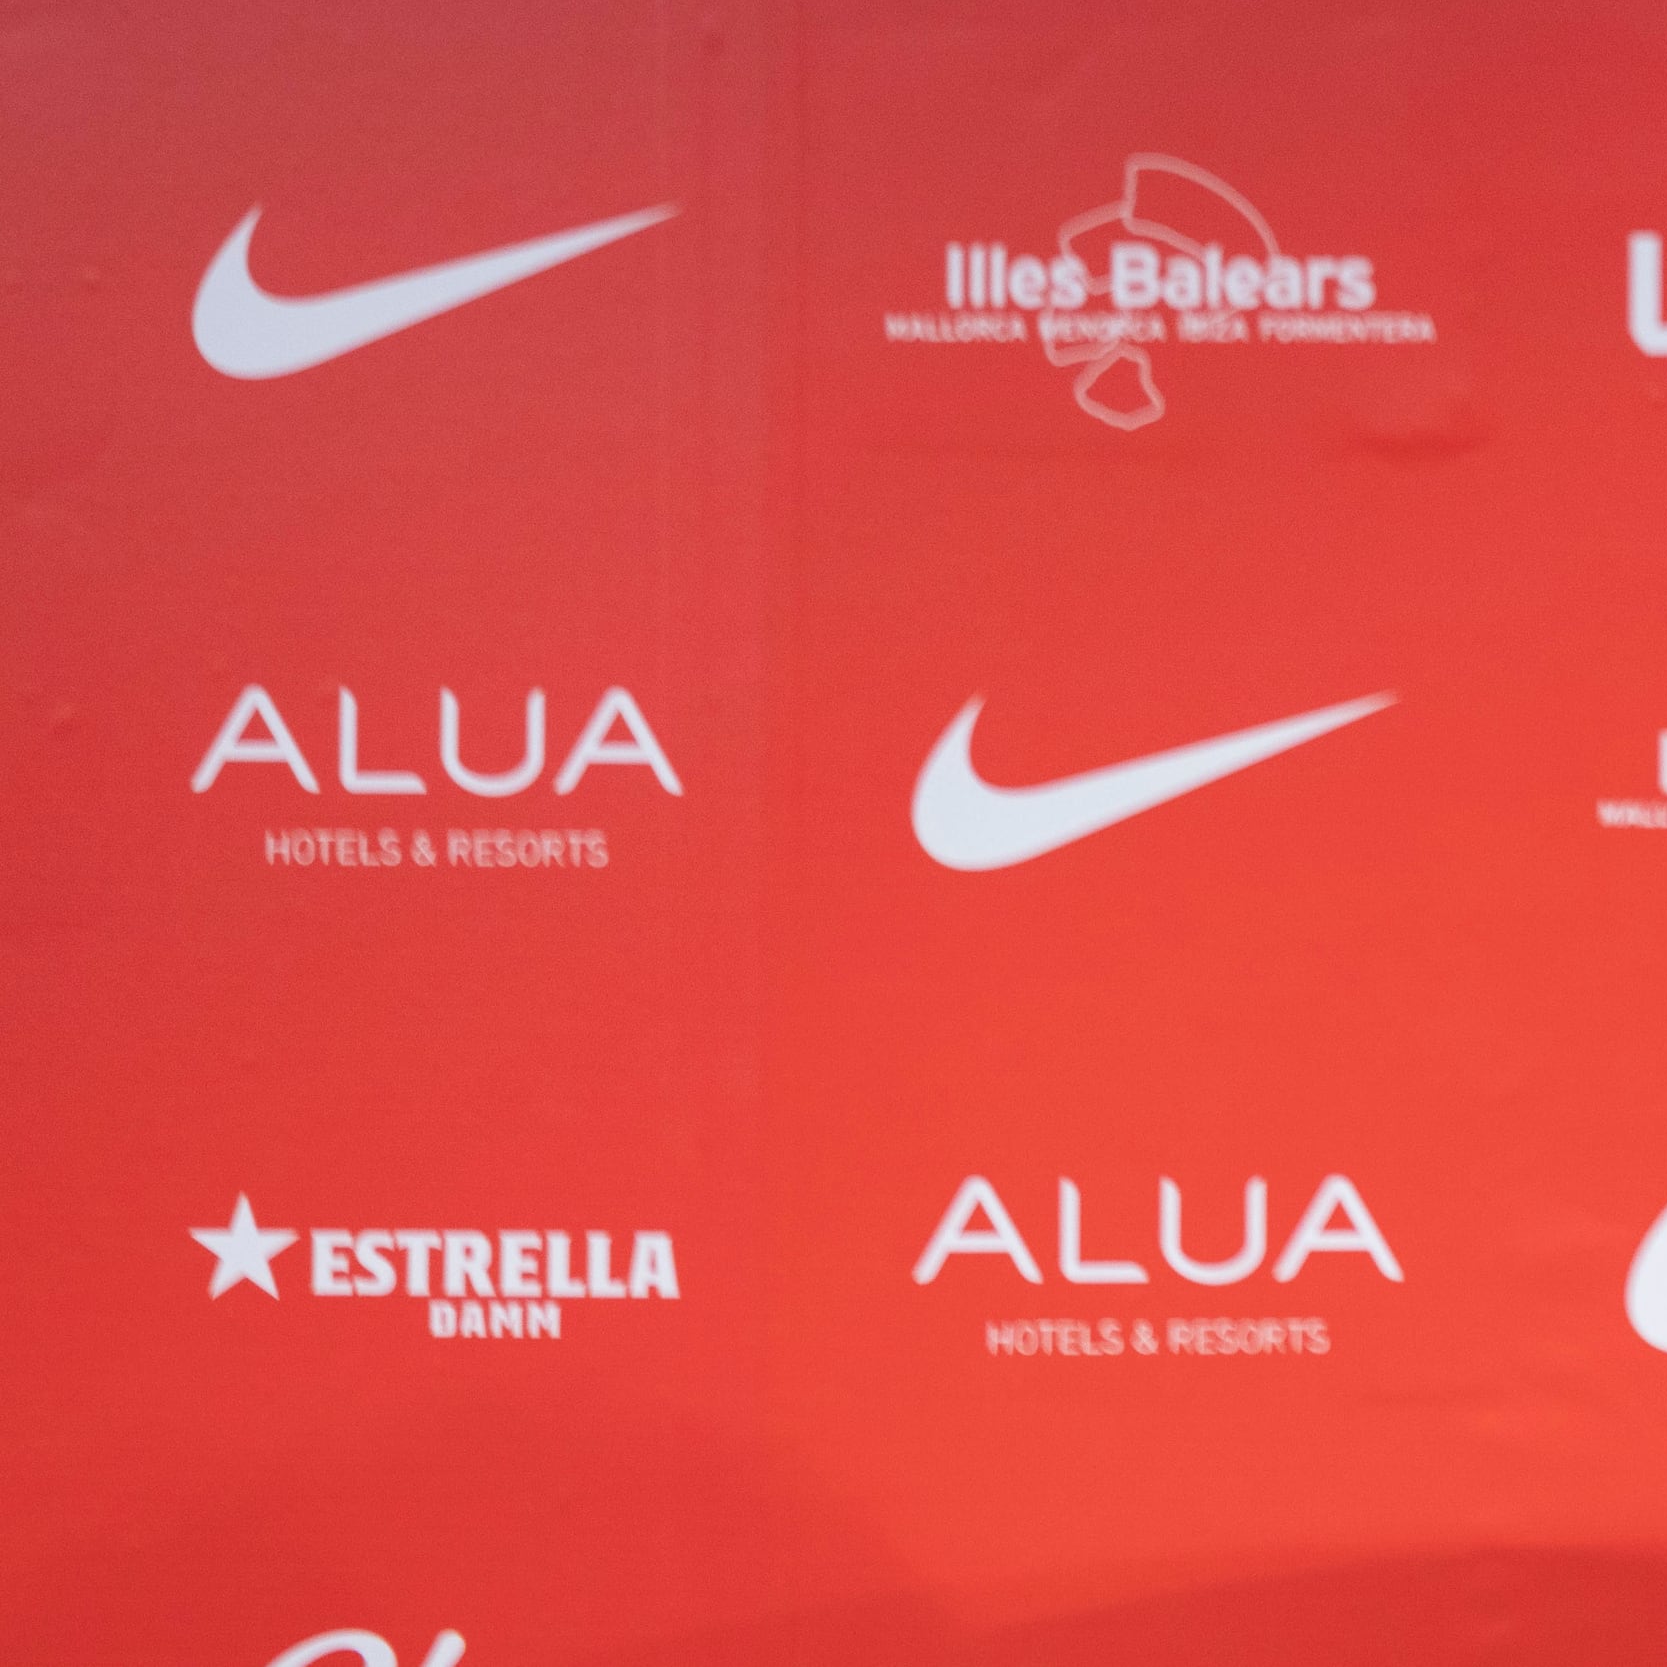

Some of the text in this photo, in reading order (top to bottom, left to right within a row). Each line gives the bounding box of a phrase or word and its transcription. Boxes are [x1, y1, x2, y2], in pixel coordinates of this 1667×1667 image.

[947, 241, 1373, 309] Illes Balears
[192, 686, 682, 797] ALUA
[312, 1230, 679, 1299] ESTRELLA
[914, 1176, 1403, 1285] ALUA
